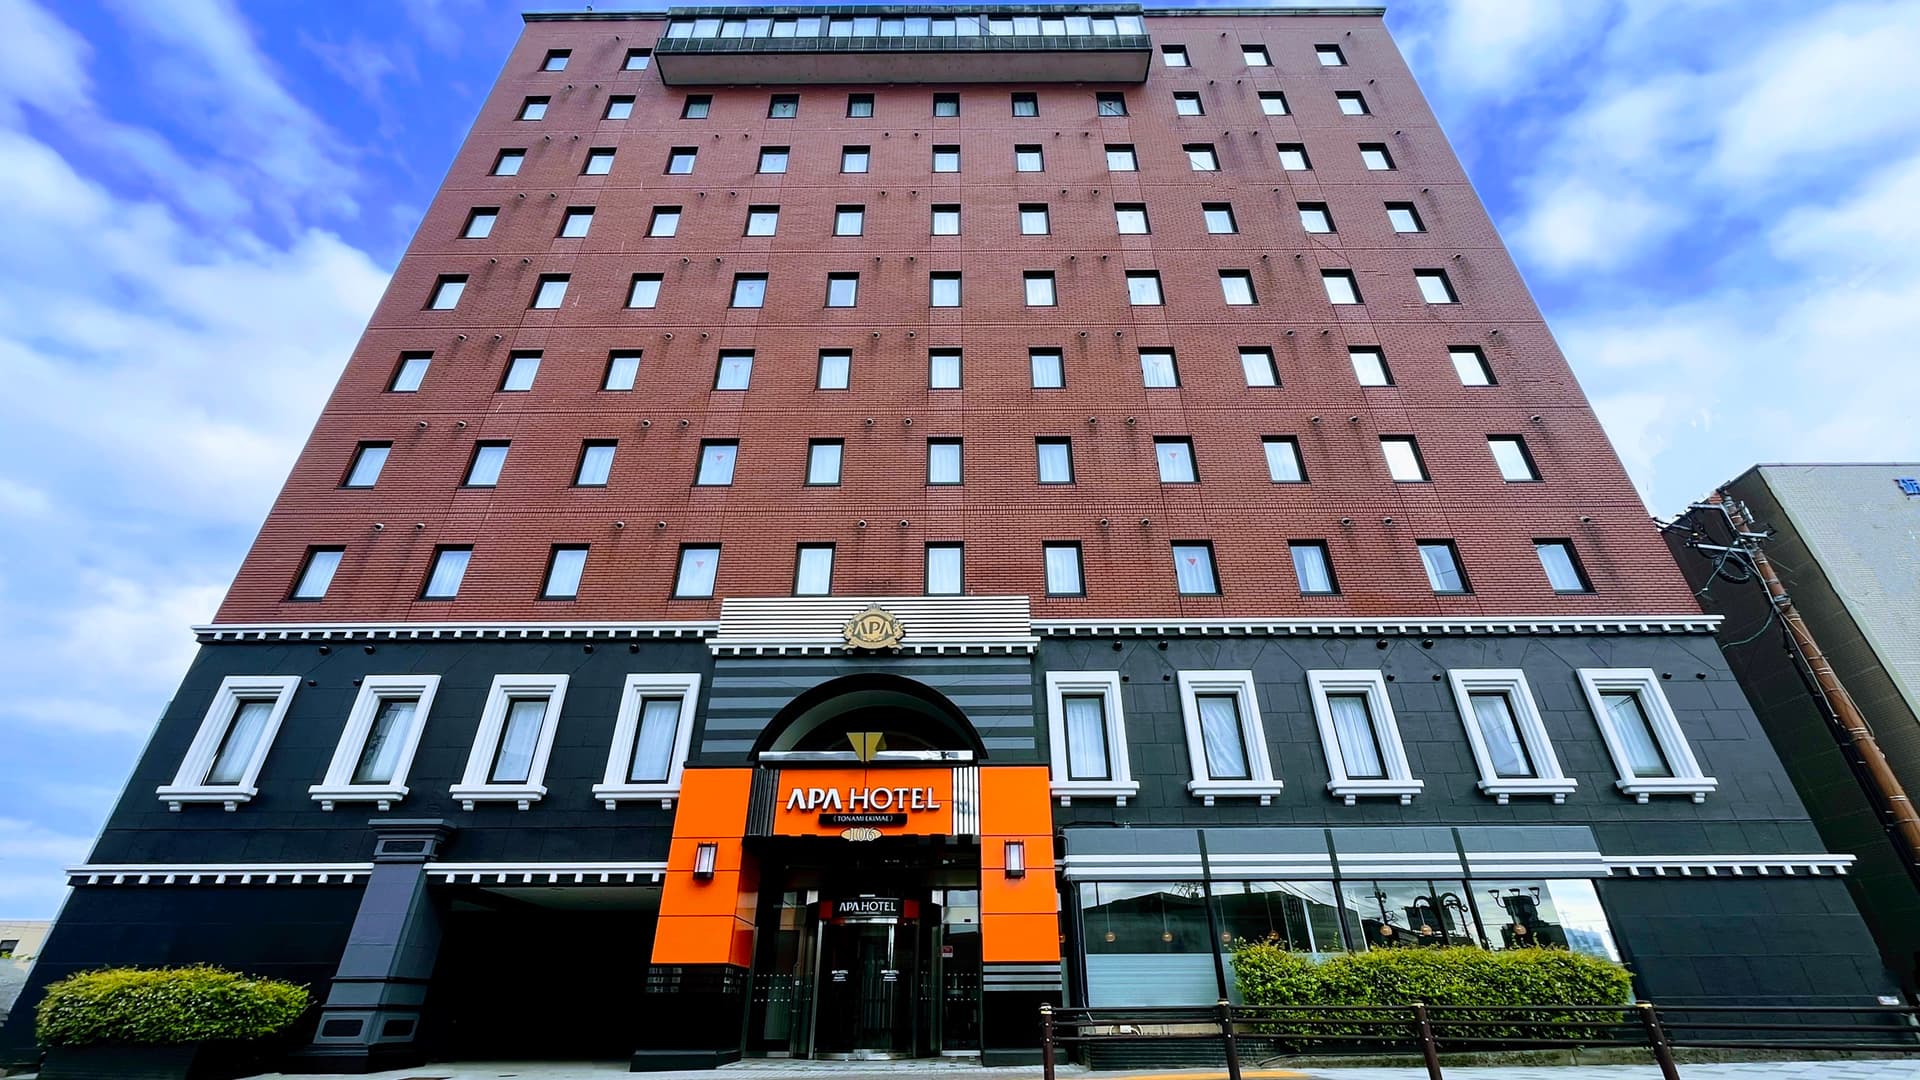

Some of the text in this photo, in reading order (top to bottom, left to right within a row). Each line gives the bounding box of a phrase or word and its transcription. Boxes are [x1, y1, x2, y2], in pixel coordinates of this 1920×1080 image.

[853, 620, 896, 635] APA
[786, 787, 940, 810] APA HOTEL
[839, 901, 896, 911] APA HOTEL
